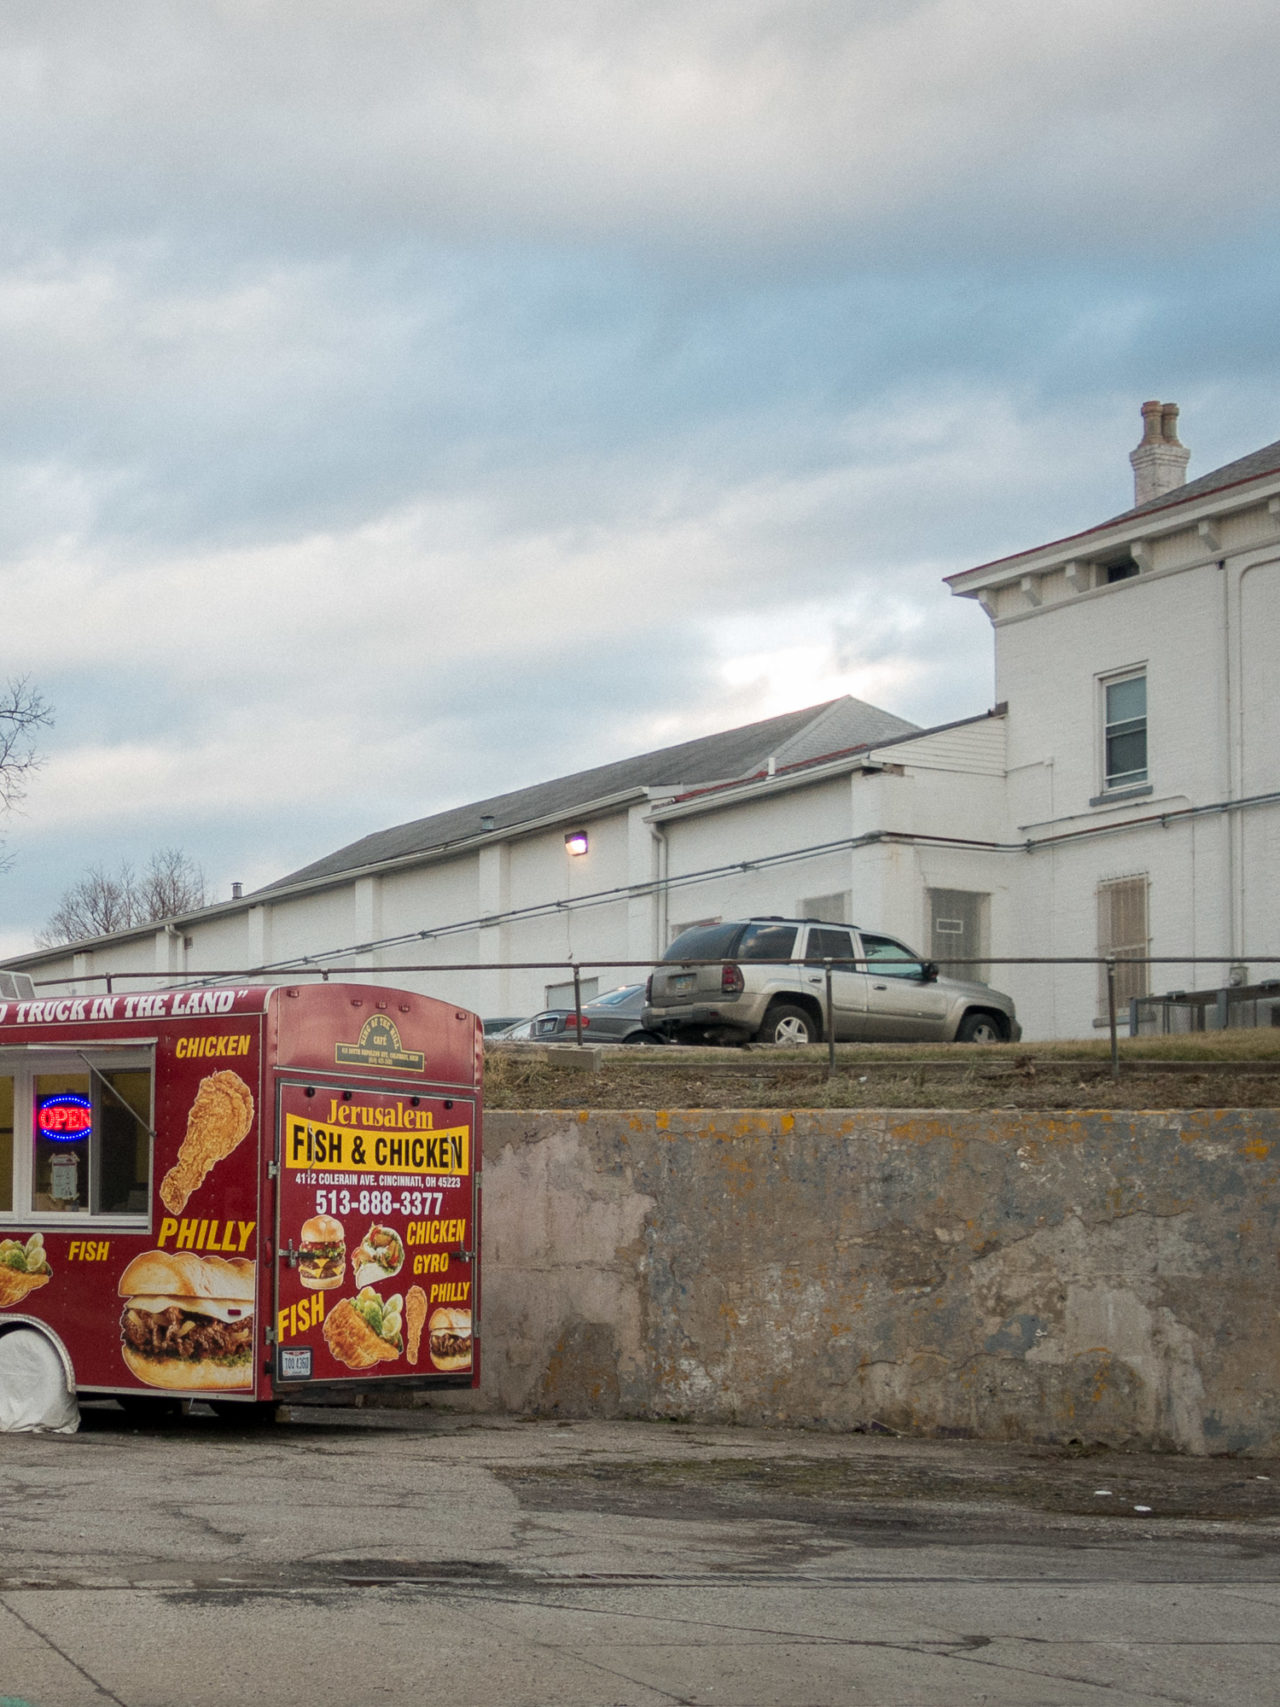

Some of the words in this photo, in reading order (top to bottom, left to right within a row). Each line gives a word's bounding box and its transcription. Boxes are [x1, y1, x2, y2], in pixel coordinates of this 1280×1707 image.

[16, 999, 86, 1023] TRUCK
[90, 997, 118, 1019] IN
[123, 993, 170, 1018] THE
[171, 989, 249, 1016] LAND"
[176, 1034, 251, 1059] CHICKEN
[38, 1106, 91, 1131] OPEN
[327, 1099, 434, 1130] Jerusalem
[293, 1124, 342, 1163] FISH
[351, 1135, 366, 1165] &
[375, 1135, 463, 1169] CHICKEN
[295, 1172, 316, 1185] 4112
[318, 1173, 358, 1186] COLERAIN
[360, 1174, 377, 1186] AVE.
[379, 1175, 424, 1188] CINCINNATI,
[426, 1176, 436, 1187] OH
[438, 1176, 461, 1189] 45223
[315, 1189, 443, 1216] 513-888-3377
[157, 1217, 257, 1252] PHILLY
[406, 1219, 466, 1246] CHICKEN
[68, 1241, 110, 1262] FISH
[413, 1252, 449, 1275] GYRO
[430, 1281, 471, 1304] PHILLY
[277, 1290, 325, 1343] FISH
